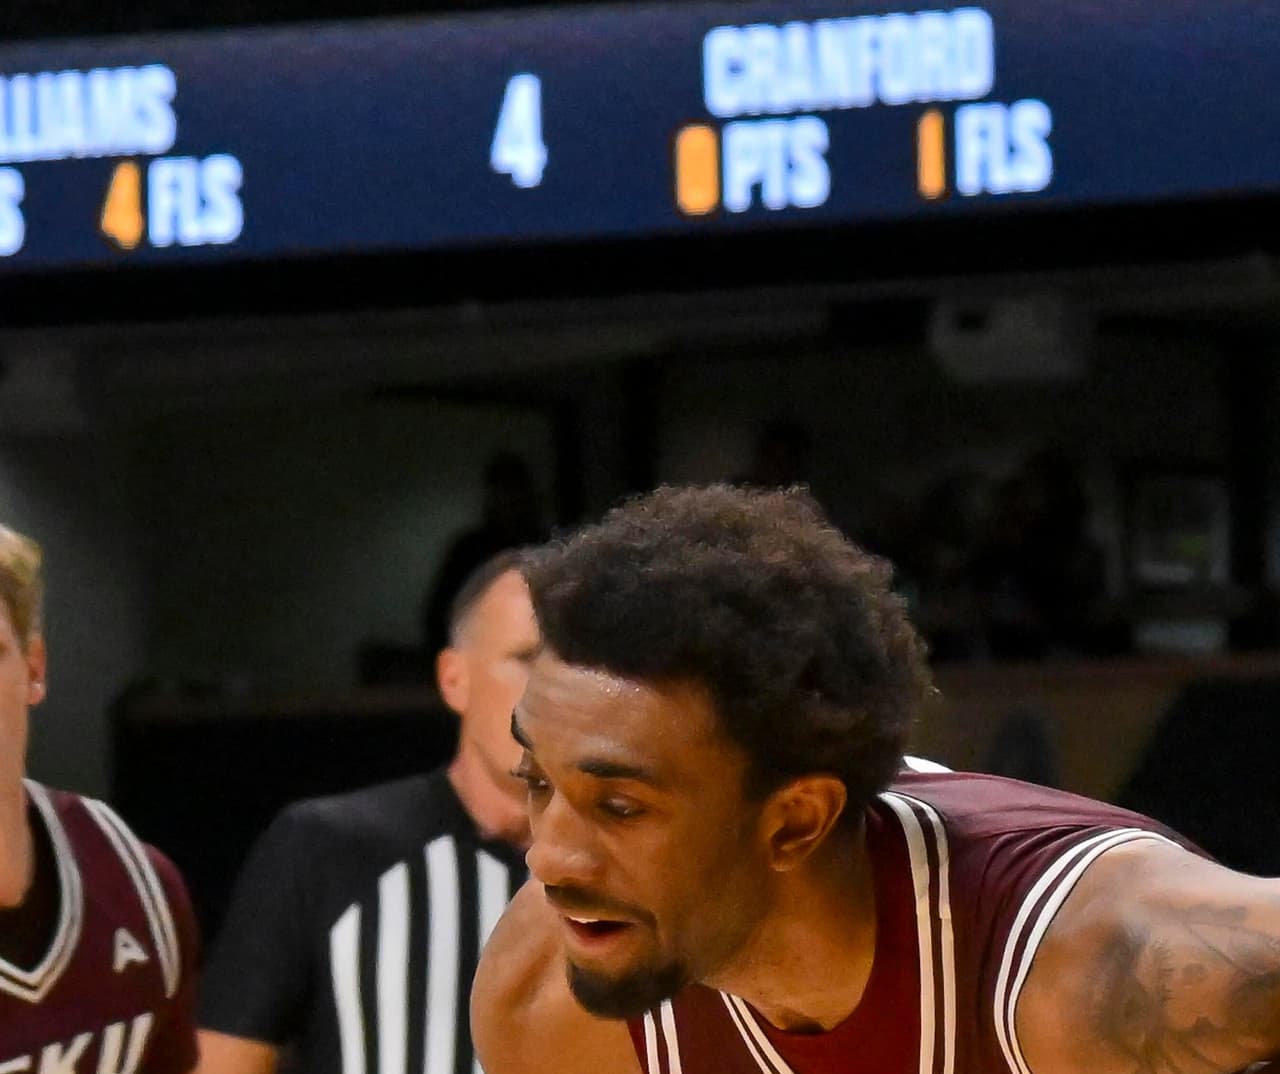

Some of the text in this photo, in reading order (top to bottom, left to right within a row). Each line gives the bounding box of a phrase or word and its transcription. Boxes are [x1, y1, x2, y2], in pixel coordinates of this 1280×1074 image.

[704, 7, 995, 117] CRANFORD
[490, 74, 548, 188] 4
[723, 117, 831, 212] PTS
[955, 99, 1053, 196] FLS
[100, 160, 143, 250] 4
[148, 153, 243, 248] FLS
